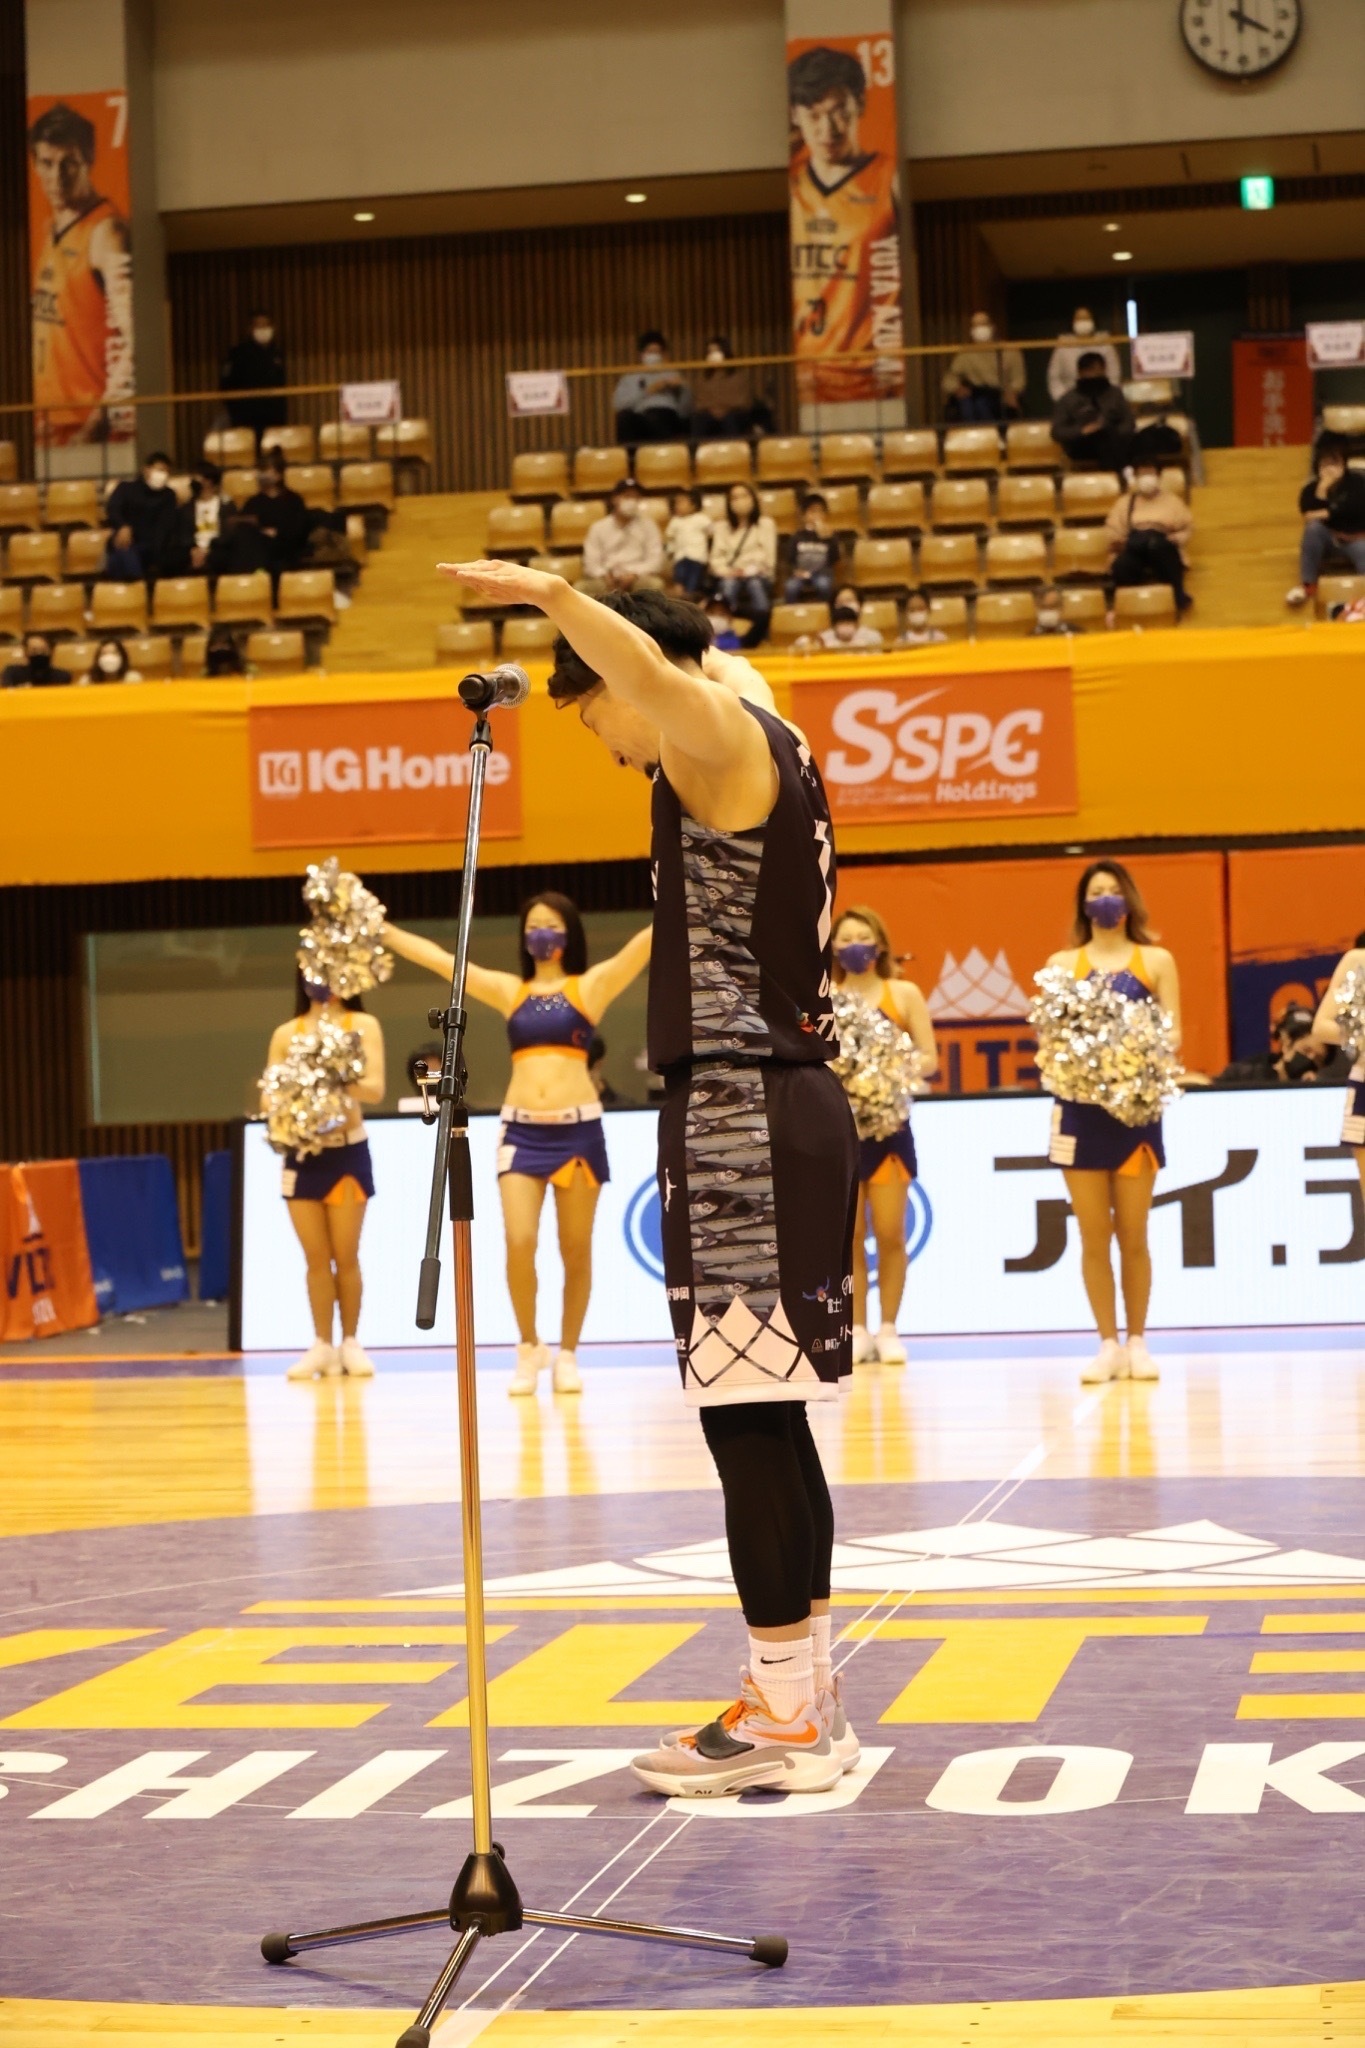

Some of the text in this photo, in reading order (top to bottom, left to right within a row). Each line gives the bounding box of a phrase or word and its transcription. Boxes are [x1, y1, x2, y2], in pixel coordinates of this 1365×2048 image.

[856, 40, 894, 88] 13
[105, 96, 128, 148] 7
[868, 234, 900, 297] YUTA
[936, 781, 1037, 803] Holdings
